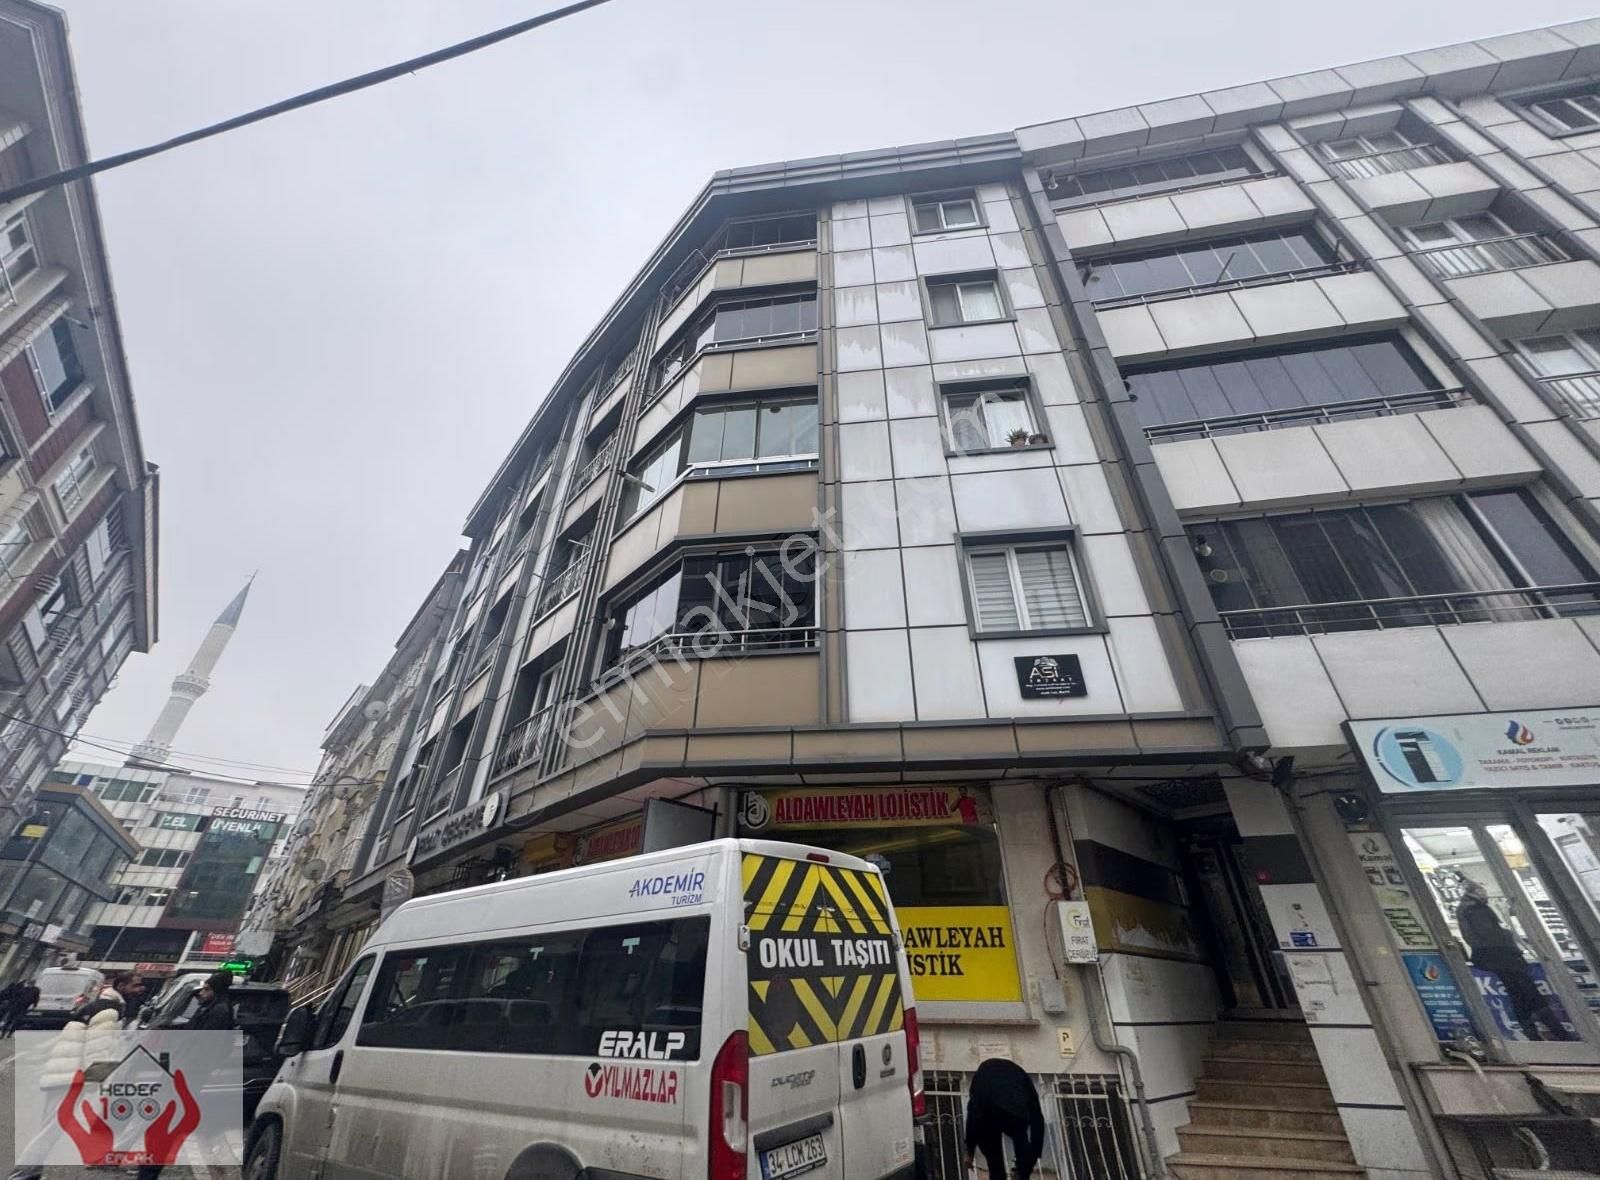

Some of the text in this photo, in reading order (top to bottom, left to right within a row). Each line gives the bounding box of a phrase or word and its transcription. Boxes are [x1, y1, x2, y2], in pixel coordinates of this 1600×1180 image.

[775, 790, 950, 822] ALDAWLEYAH LOJİSTİK
[629, 867, 705, 897] AKDEMİR
[671, 892, 702, 906] TURİZM
[901, 927, 1006, 949] AWLEYAH
[759, 938, 892, 969] OKUL TAŞITI
[598, 1030, 686, 1060] ERALP
[603, 1065, 678, 1105] YILMAZLAR
[768, 1150, 783, 1176] 34
[785, 1142, 805, 1169] LCM
[806, 1136, 823, 1161] 263
